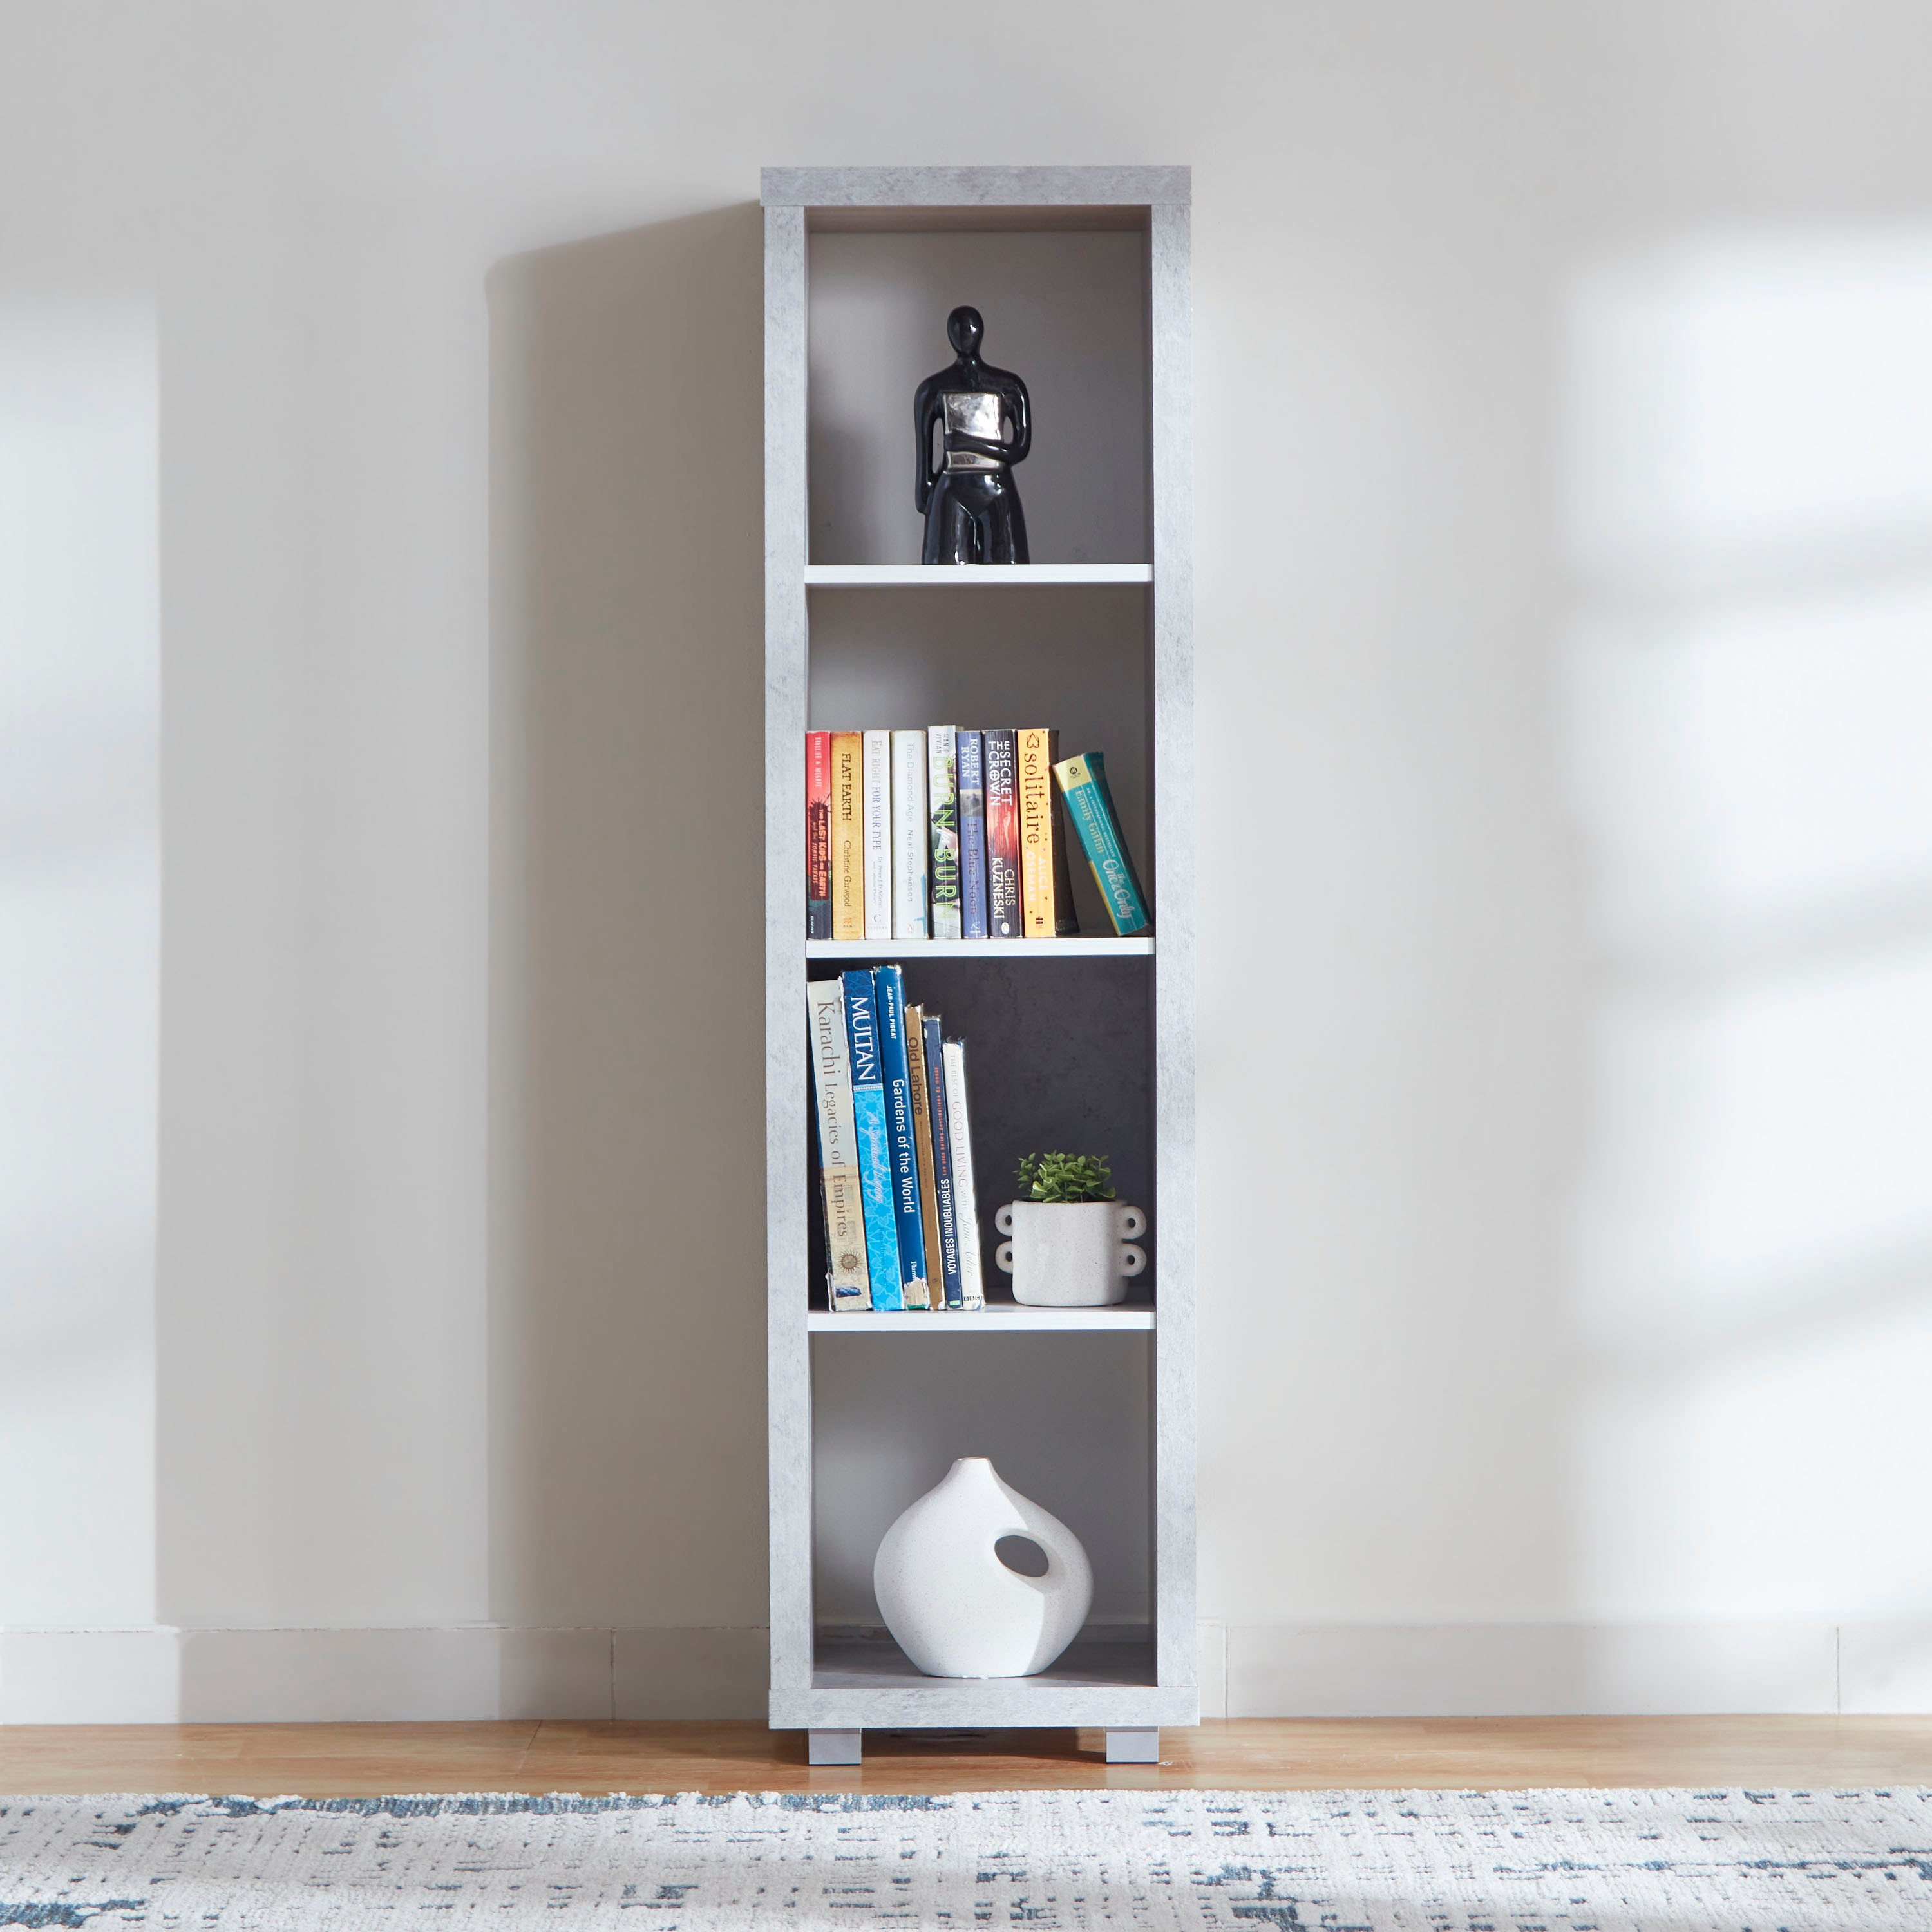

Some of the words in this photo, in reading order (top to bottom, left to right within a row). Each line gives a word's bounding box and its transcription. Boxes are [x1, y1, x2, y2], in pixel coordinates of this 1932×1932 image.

[871, 739, 882, 756] EAT
[961, 746, 970, 777] RYAN
[969, 738, 980, 785] ROBERT
[988, 741, 1010, 750] THE
[842, 753, 852, 781] FLAT
[871, 758, 881, 784] RIGHT
[906, 762, 914, 802] Diamond
[989, 750, 1000, 806] CROWN
[999, 750, 1012, 806] SECRET
[842, 784, 852, 821] EARTH
[871, 786, 881, 802] FOR
[933, 755, 955, 827] BURN
[1024, 753, 1045, 844] solitaire
[819, 820, 827, 840] LAST
[871, 805, 882, 828] YOUR
[905, 804, 914, 822] Age
[1075, 790, 1094, 822] Emily
[1088, 822, 1105, 853] Giffin
[872, 830, 882, 850] TYPE
[967, 822, 978, 844] The
[819, 842, 827, 861] KIDS
[843, 840, 851, 873] Christine
[968, 849, 978, 875] Blue
[819, 871, 827, 896] EARTH
[843, 875, 851, 907] Garwood
[905, 852, 914, 902] Stephenson
[934, 849, 957, 920] BURN
[992, 857, 1005, 918] KUZNESKI
[1003, 869, 1016, 906] CHRIS
[1026, 851, 1036, 901] OSEMAN
[1038, 857, 1048, 891] ALICE
[1102, 859, 1121, 884] One
[1114, 889, 1135, 918] Only
[1117, 872, 1126, 884] The
[969, 880, 980, 915] Noon
[886, 985, 895, 1017] JEAN-PAUL
[817, 1001, 840, 1075] Karachi
[850, 996, 876, 1081] MULTAN
[908, 1037, 919, 1062] Old
[892, 1079, 905, 1132] Gardens
[911, 1066, 922, 1115] Lahore
[952, 1088, 960, 1098] OF
[822, 1083, 842, 1144] Legacies
[952, 1101, 965, 1141] GOOD
[831, 1150, 846, 1168] of
[897, 1135, 911, 1149] of
[899, 1151, 911, 1173] the
[955, 1146, 968, 1188] LIVING
[831, 1174, 849, 1237] Empires
[901, 1176, 915, 1213] World
[940, 1179, 953, 1237] INOUBLIABLES
[958, 1212, 974, 1240] Jane
[945, 1238, 957, 1275] VOYAGES
